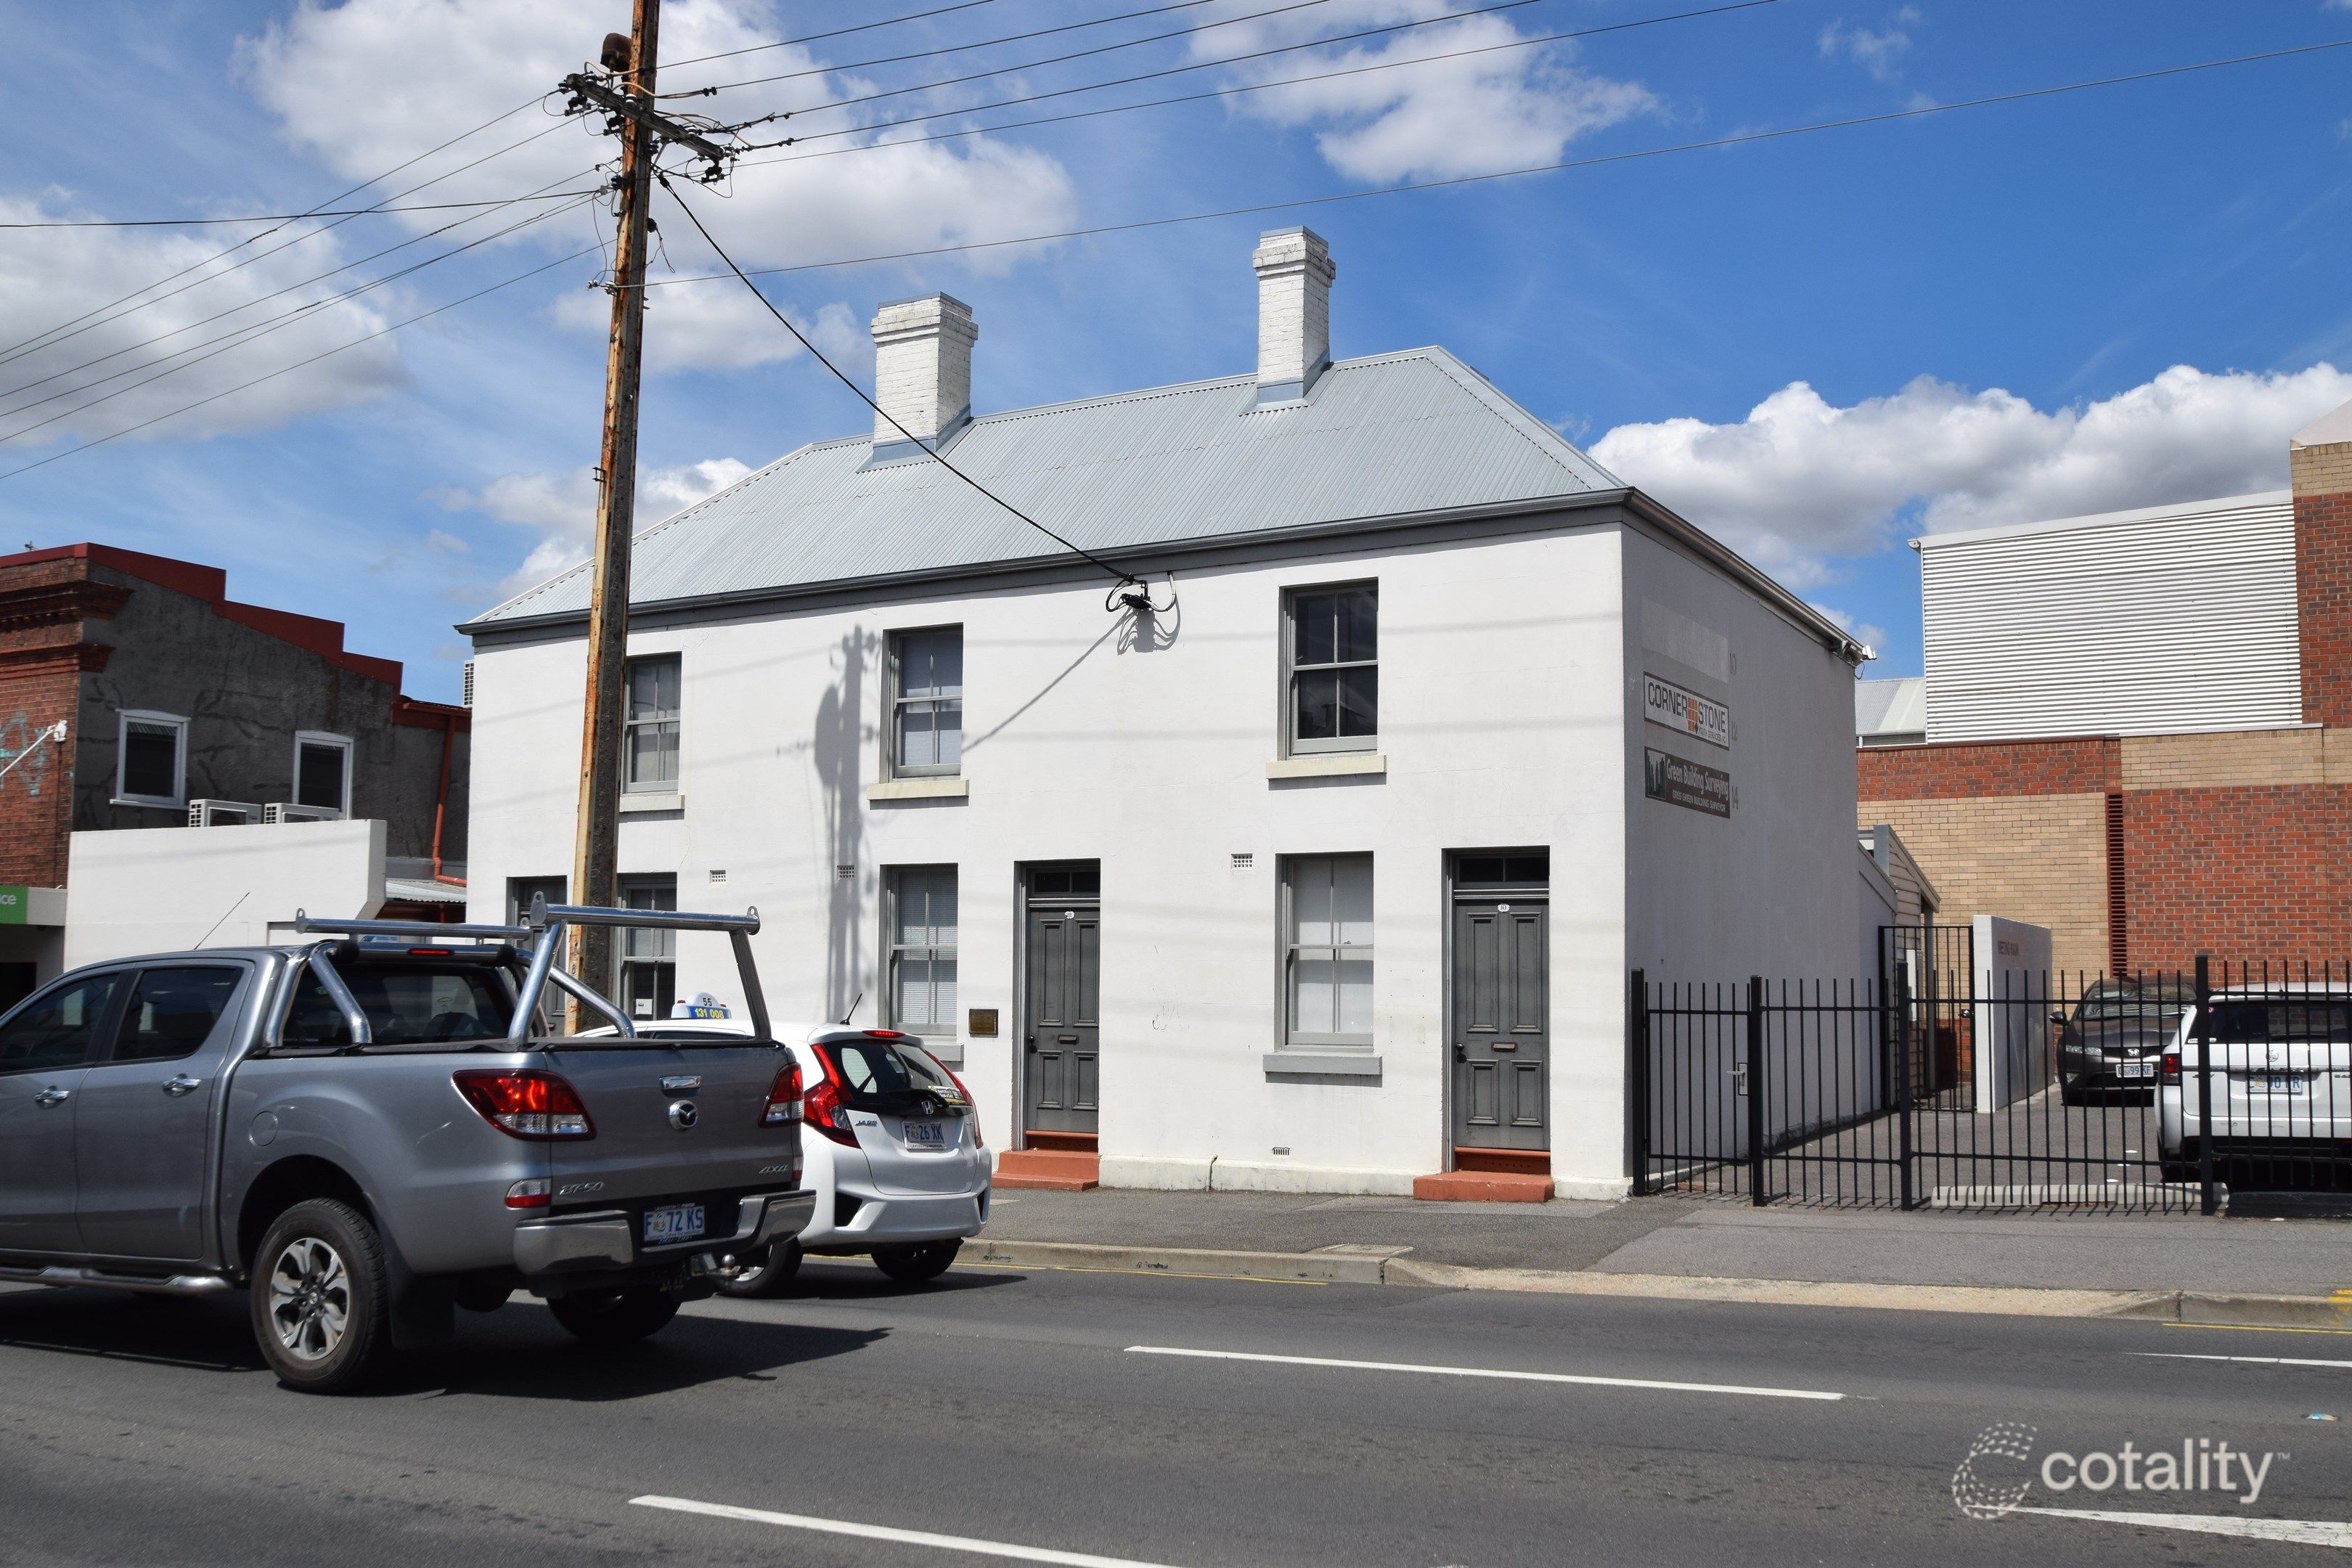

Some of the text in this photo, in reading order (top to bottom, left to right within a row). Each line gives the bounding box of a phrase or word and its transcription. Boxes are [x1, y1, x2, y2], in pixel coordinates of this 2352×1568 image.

[1648, 682, 1726, 733] CORNER STONE
[1666, 759, 1728, 801] Green Building Surveying
[1731, 785, 1739, 810] 14
[702, 997, 712, 1007] 55
[695, 1008, 724, 1020] 131 008
[2129, 1066, 2139, 1074] 99
[905, 1125, 943, 1140] F 26 XK
[558, 1181, 604, 1196] BT-50
[645, 1208, 703, 1236] F 72 KS
